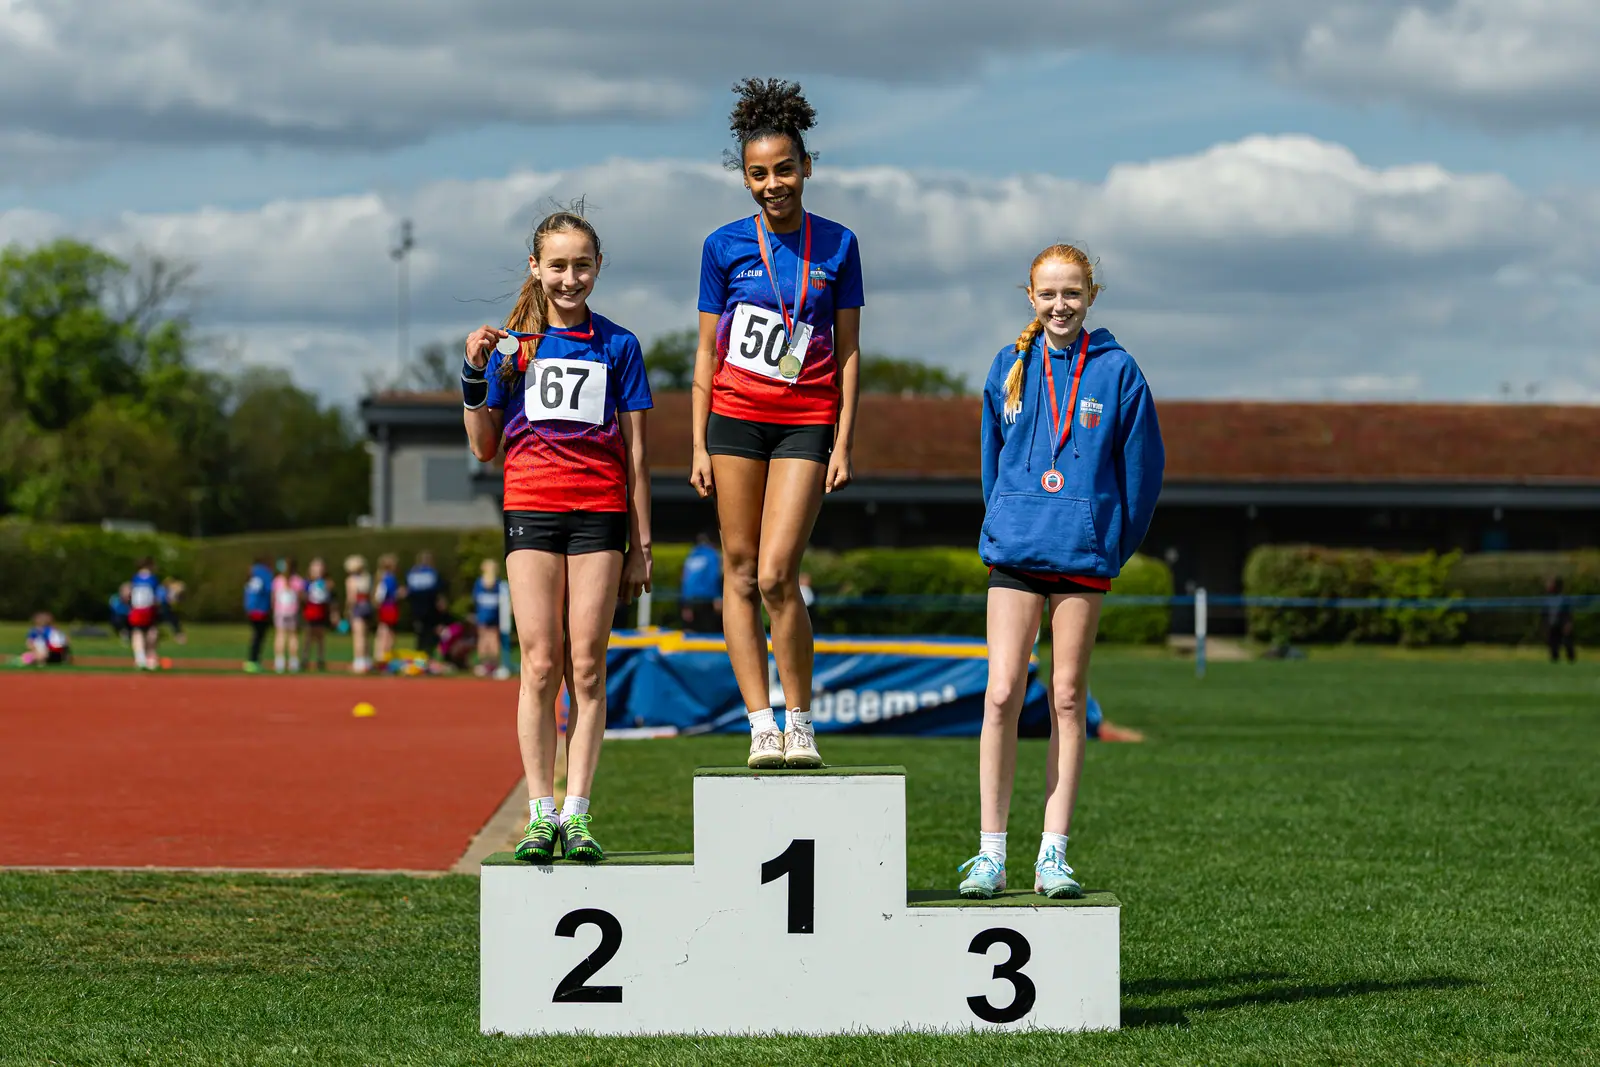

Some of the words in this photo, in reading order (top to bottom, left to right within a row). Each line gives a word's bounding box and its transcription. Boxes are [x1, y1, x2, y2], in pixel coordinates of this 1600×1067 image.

[540, 365, 590, 410] 67
[739, 313, 790, 367] 50
[761, 838, 815, 934] 1
[552, 908, 623, 1003] 2
[966, 927, 1036, 1023] 3
